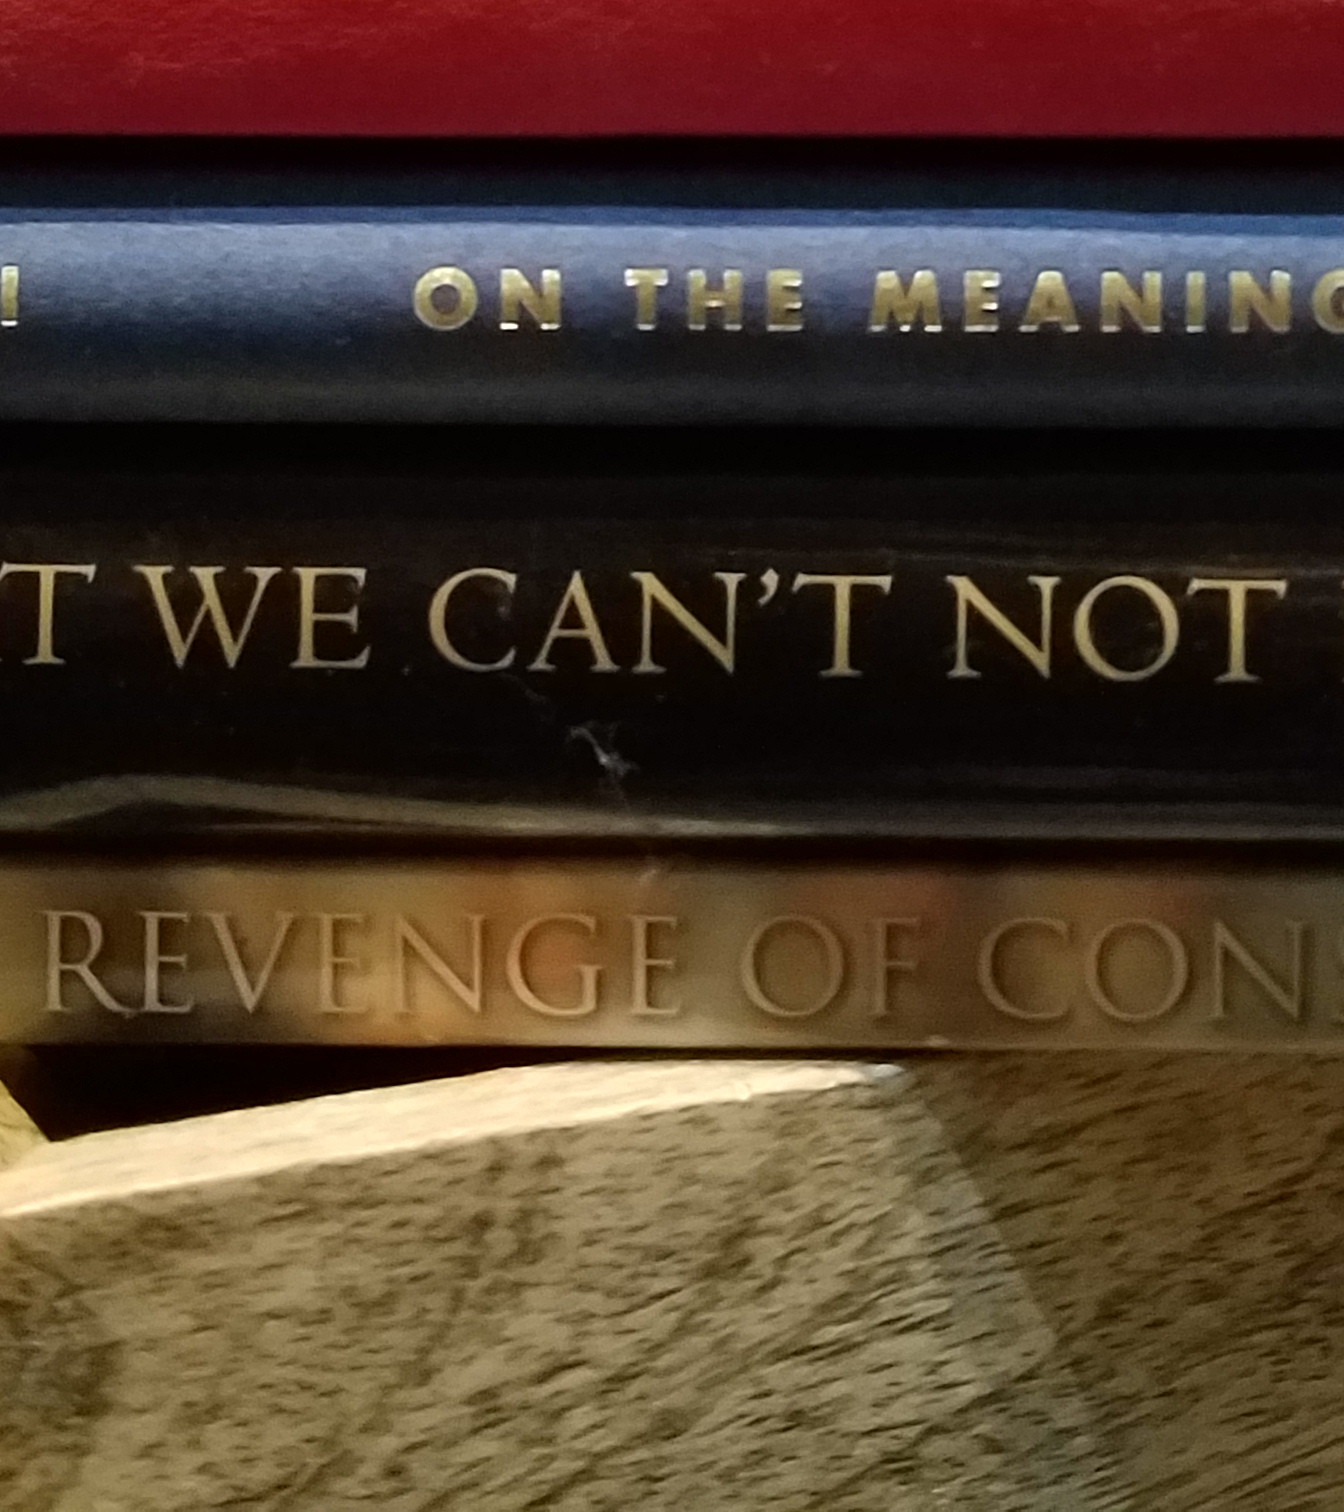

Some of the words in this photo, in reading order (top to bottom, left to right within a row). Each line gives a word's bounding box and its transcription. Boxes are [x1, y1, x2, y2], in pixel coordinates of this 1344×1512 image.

[412, 265, 564, 331] ON
[623, 267, 806, 333] THE
[133, 563, 372, 671] WE
[428, 567, 893, 678] CAN'T
[945, 574, 1288, 683] NOT
[43, 908, 681, 1021] REVENGE
[741, 915, 924, 1021] OF
